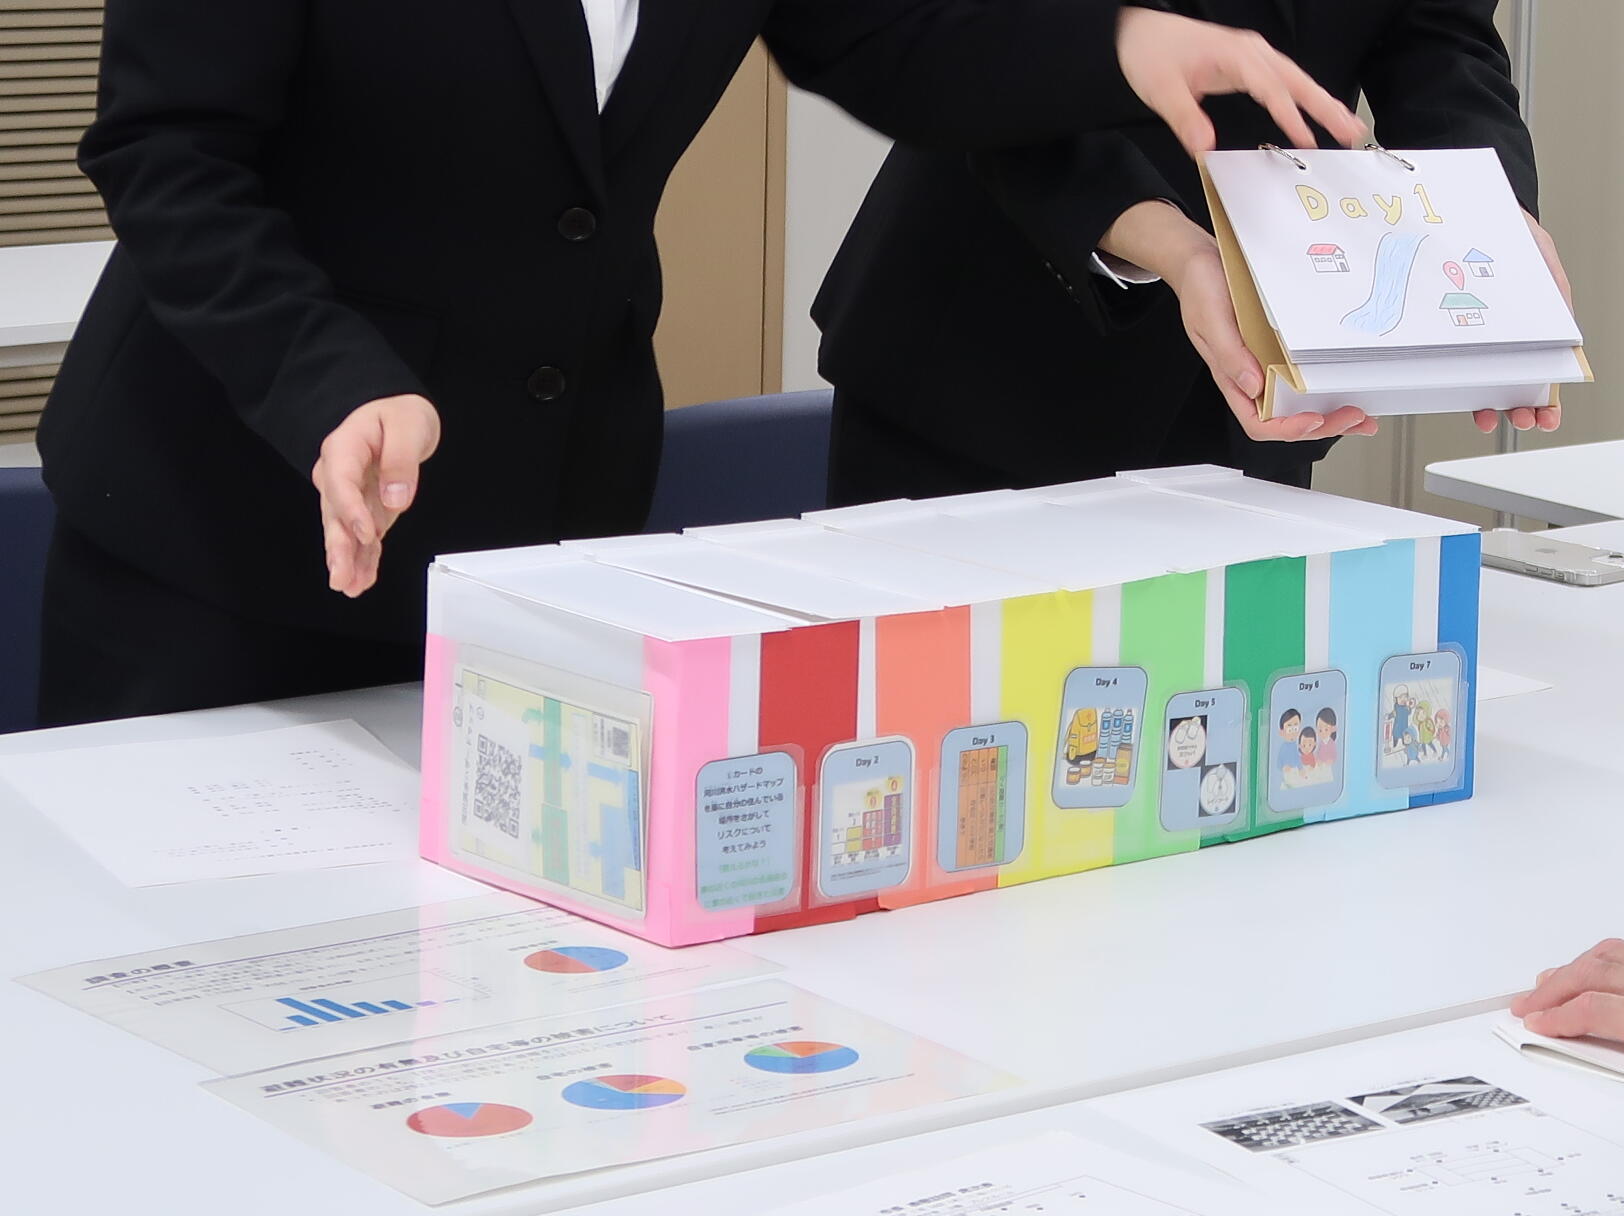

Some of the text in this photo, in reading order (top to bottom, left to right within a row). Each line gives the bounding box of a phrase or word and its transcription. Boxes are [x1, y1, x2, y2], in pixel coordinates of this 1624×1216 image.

[1410, 662, 1424, 672] Day
[1095, 678, 1110, 688] Day
[1299, 682, 1313, 692] Day
[1195, 699, 1209, 709] Day
[972, 737, 988, 747] Day
[855, 758, 872, 768] Day
[717, 825, 772, 840] リスクについて
[721, 840, 767, 854] 考えてみよう
